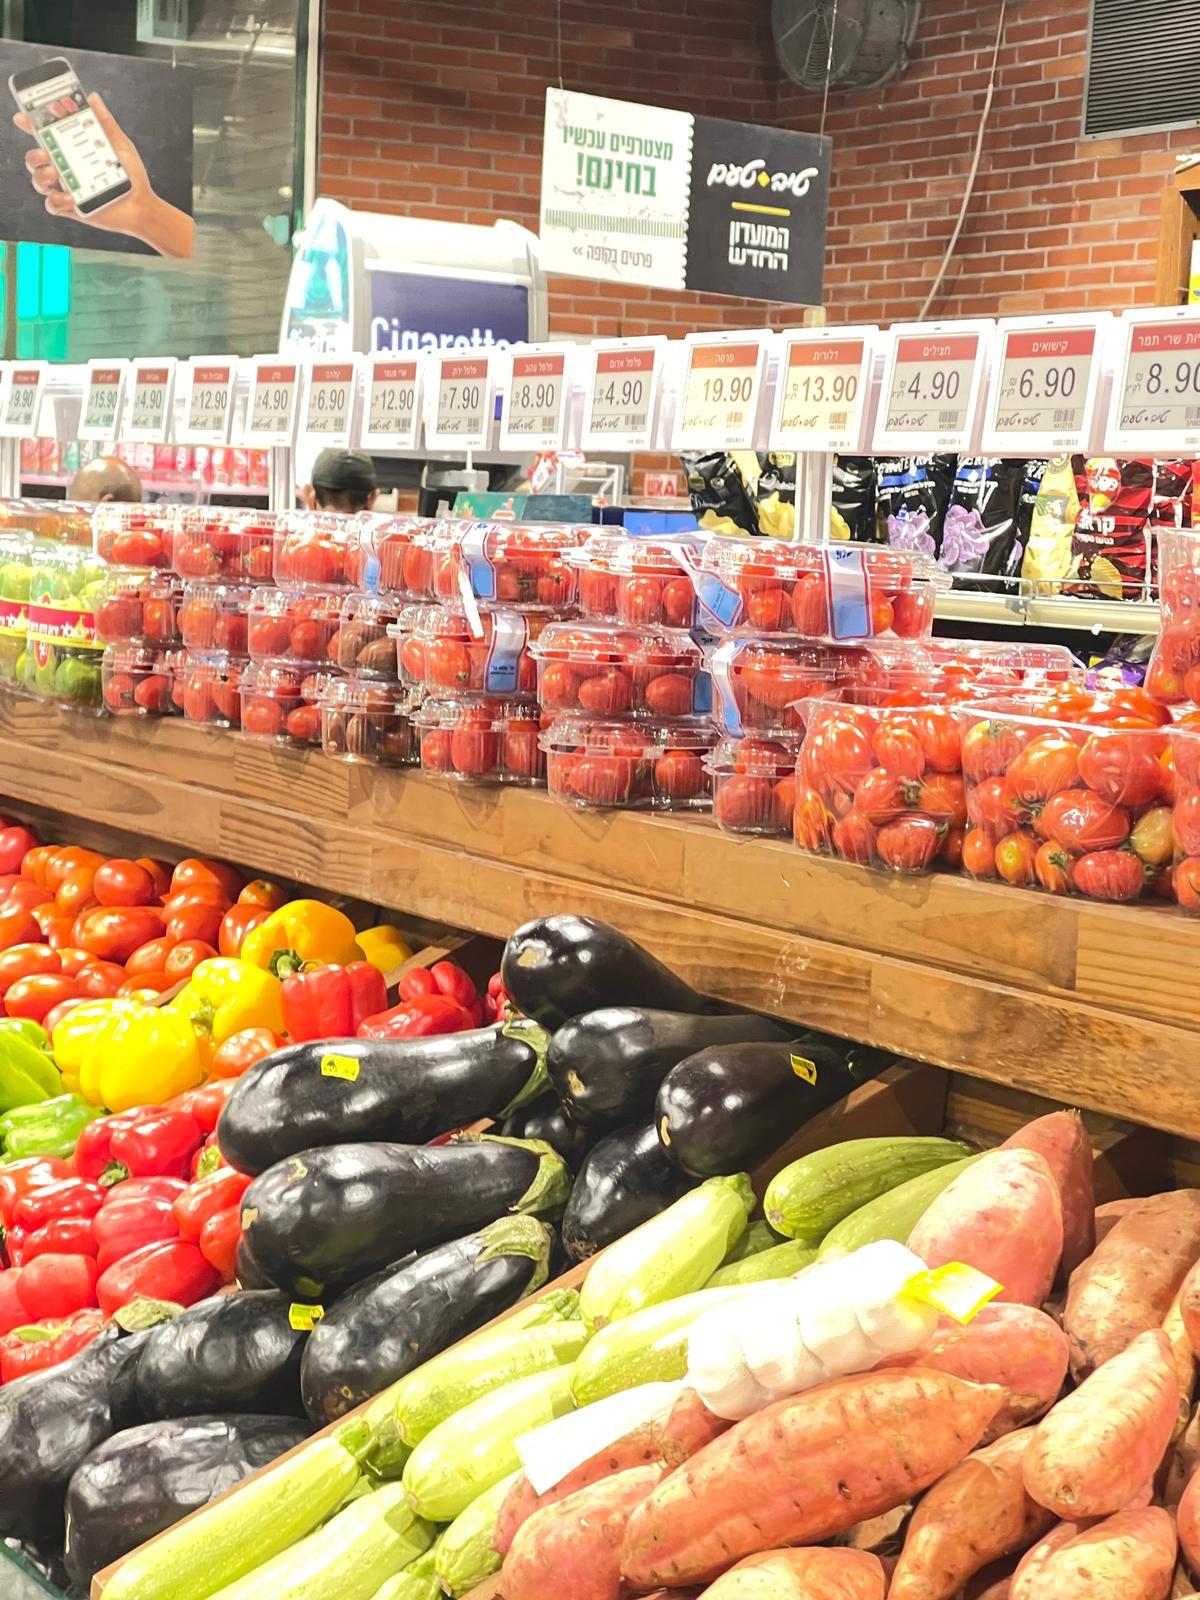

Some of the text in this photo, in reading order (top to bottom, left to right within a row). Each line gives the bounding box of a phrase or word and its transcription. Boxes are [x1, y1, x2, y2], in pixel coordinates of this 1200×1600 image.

[563, 125, 673, 161] מצטרפים עכשיו
[576, 152, 656, 197] בחינם!
[729, 220, 790, 250] המועדון
[586, 245, 653, 269] פרטים בקופה
[728, 246, 788, 271] החדש
[923, 345, 951, 357] חצילים
[1032, 340, 1069, 353] קישואים
[1138, 335, 1160, 347] תמר
[1164, 334, 1182, 345] שרי
[609, 356, 642, 368] פלפל אדום
[605, 379, 643, 406] 4.90
[704, 376, 753, 402] 19.90
[802, 375, 857, 402] 13.90
[908, 370, 960, 400] 4.90
[1019, 367, 1076, 398] 6.90
[13, 389, 34, 407] 9.90
[95, 390, 118, 409] 15.90
[140, 389, 162, 409] 4.90
[200, 389, 228, 409] 12.90
[262, 389, 288, 410] 4.90
[317, 388, 345, 410] 6.90
[381, 388, 415, 411] 12.90
[449, 386, 480, 410] 7.90
[521, 383, 555, 409] 8.90
